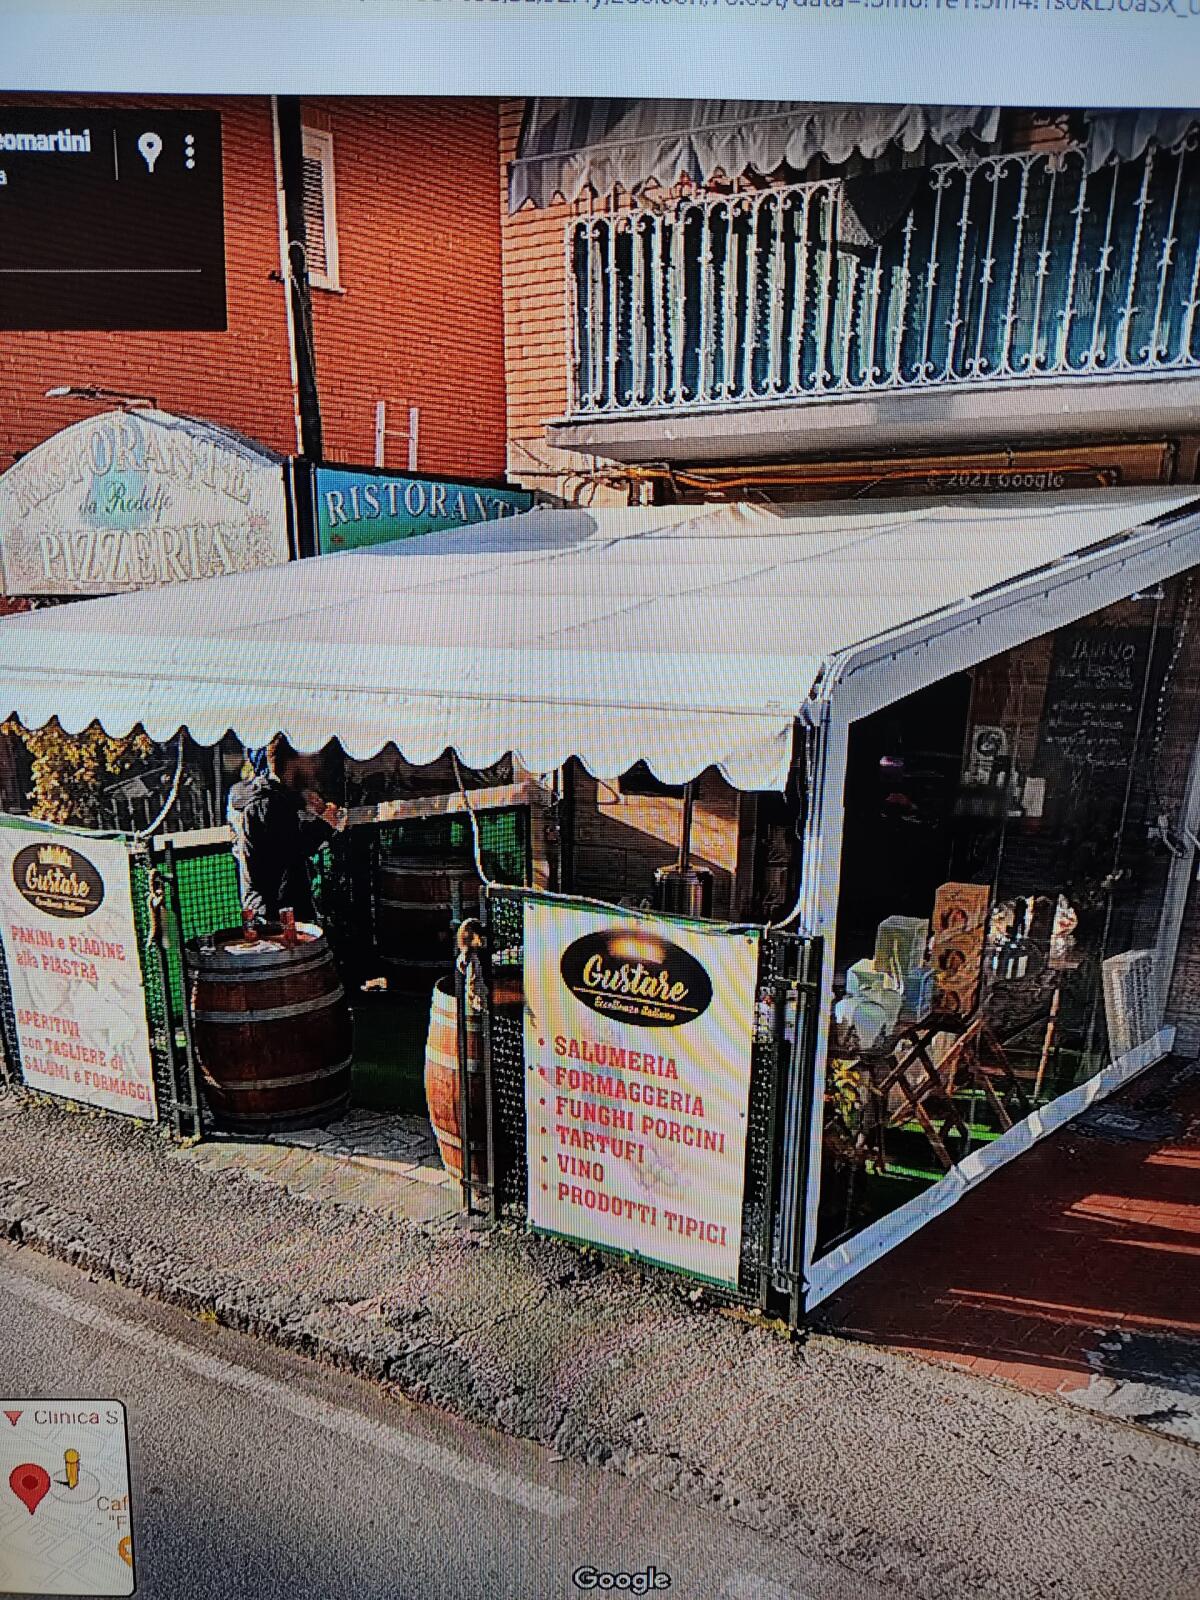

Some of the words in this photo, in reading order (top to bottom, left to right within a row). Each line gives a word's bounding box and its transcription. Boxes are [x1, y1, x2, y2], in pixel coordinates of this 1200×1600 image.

[999, 470, 1065, 489] Google
[324, 482, 524, 527] RISTORANT
[40, 524, 238, 585] PIZZERIA
[26, 863, 91, 898] Gustare
[41, 954, 99, 981] PIASTRA
[69, 935, 126, 961] PIADINE
[583, 954, 689, 1002] Gustare
[45, 1039, 107, 1067] TAGLIERE
[555, 1035, 679, 1081] SALUMERIA
[24, 1055, 70, 1081] SALUMI
[74, 1070, 82, 1084] e
[84, 1070, 152, 1101] FORMAGGI
[556, 1066, 705, 1118] FORMAGGERIA
[556, 1095, 634, 1133] FUNGHI
[642, 1115, 727, 1155] PORCINI
[557, 1125, 645, 1164] TARTUFI
[558, 1154, 605, 1183] VINO
[558, 1182, 658, 1227] PRODOTTI
[664, 1209, 728, 1248] TIPICI
[34, 1409, 100, 1425] Clinica
[573, 1565, 672, 1596] Google
